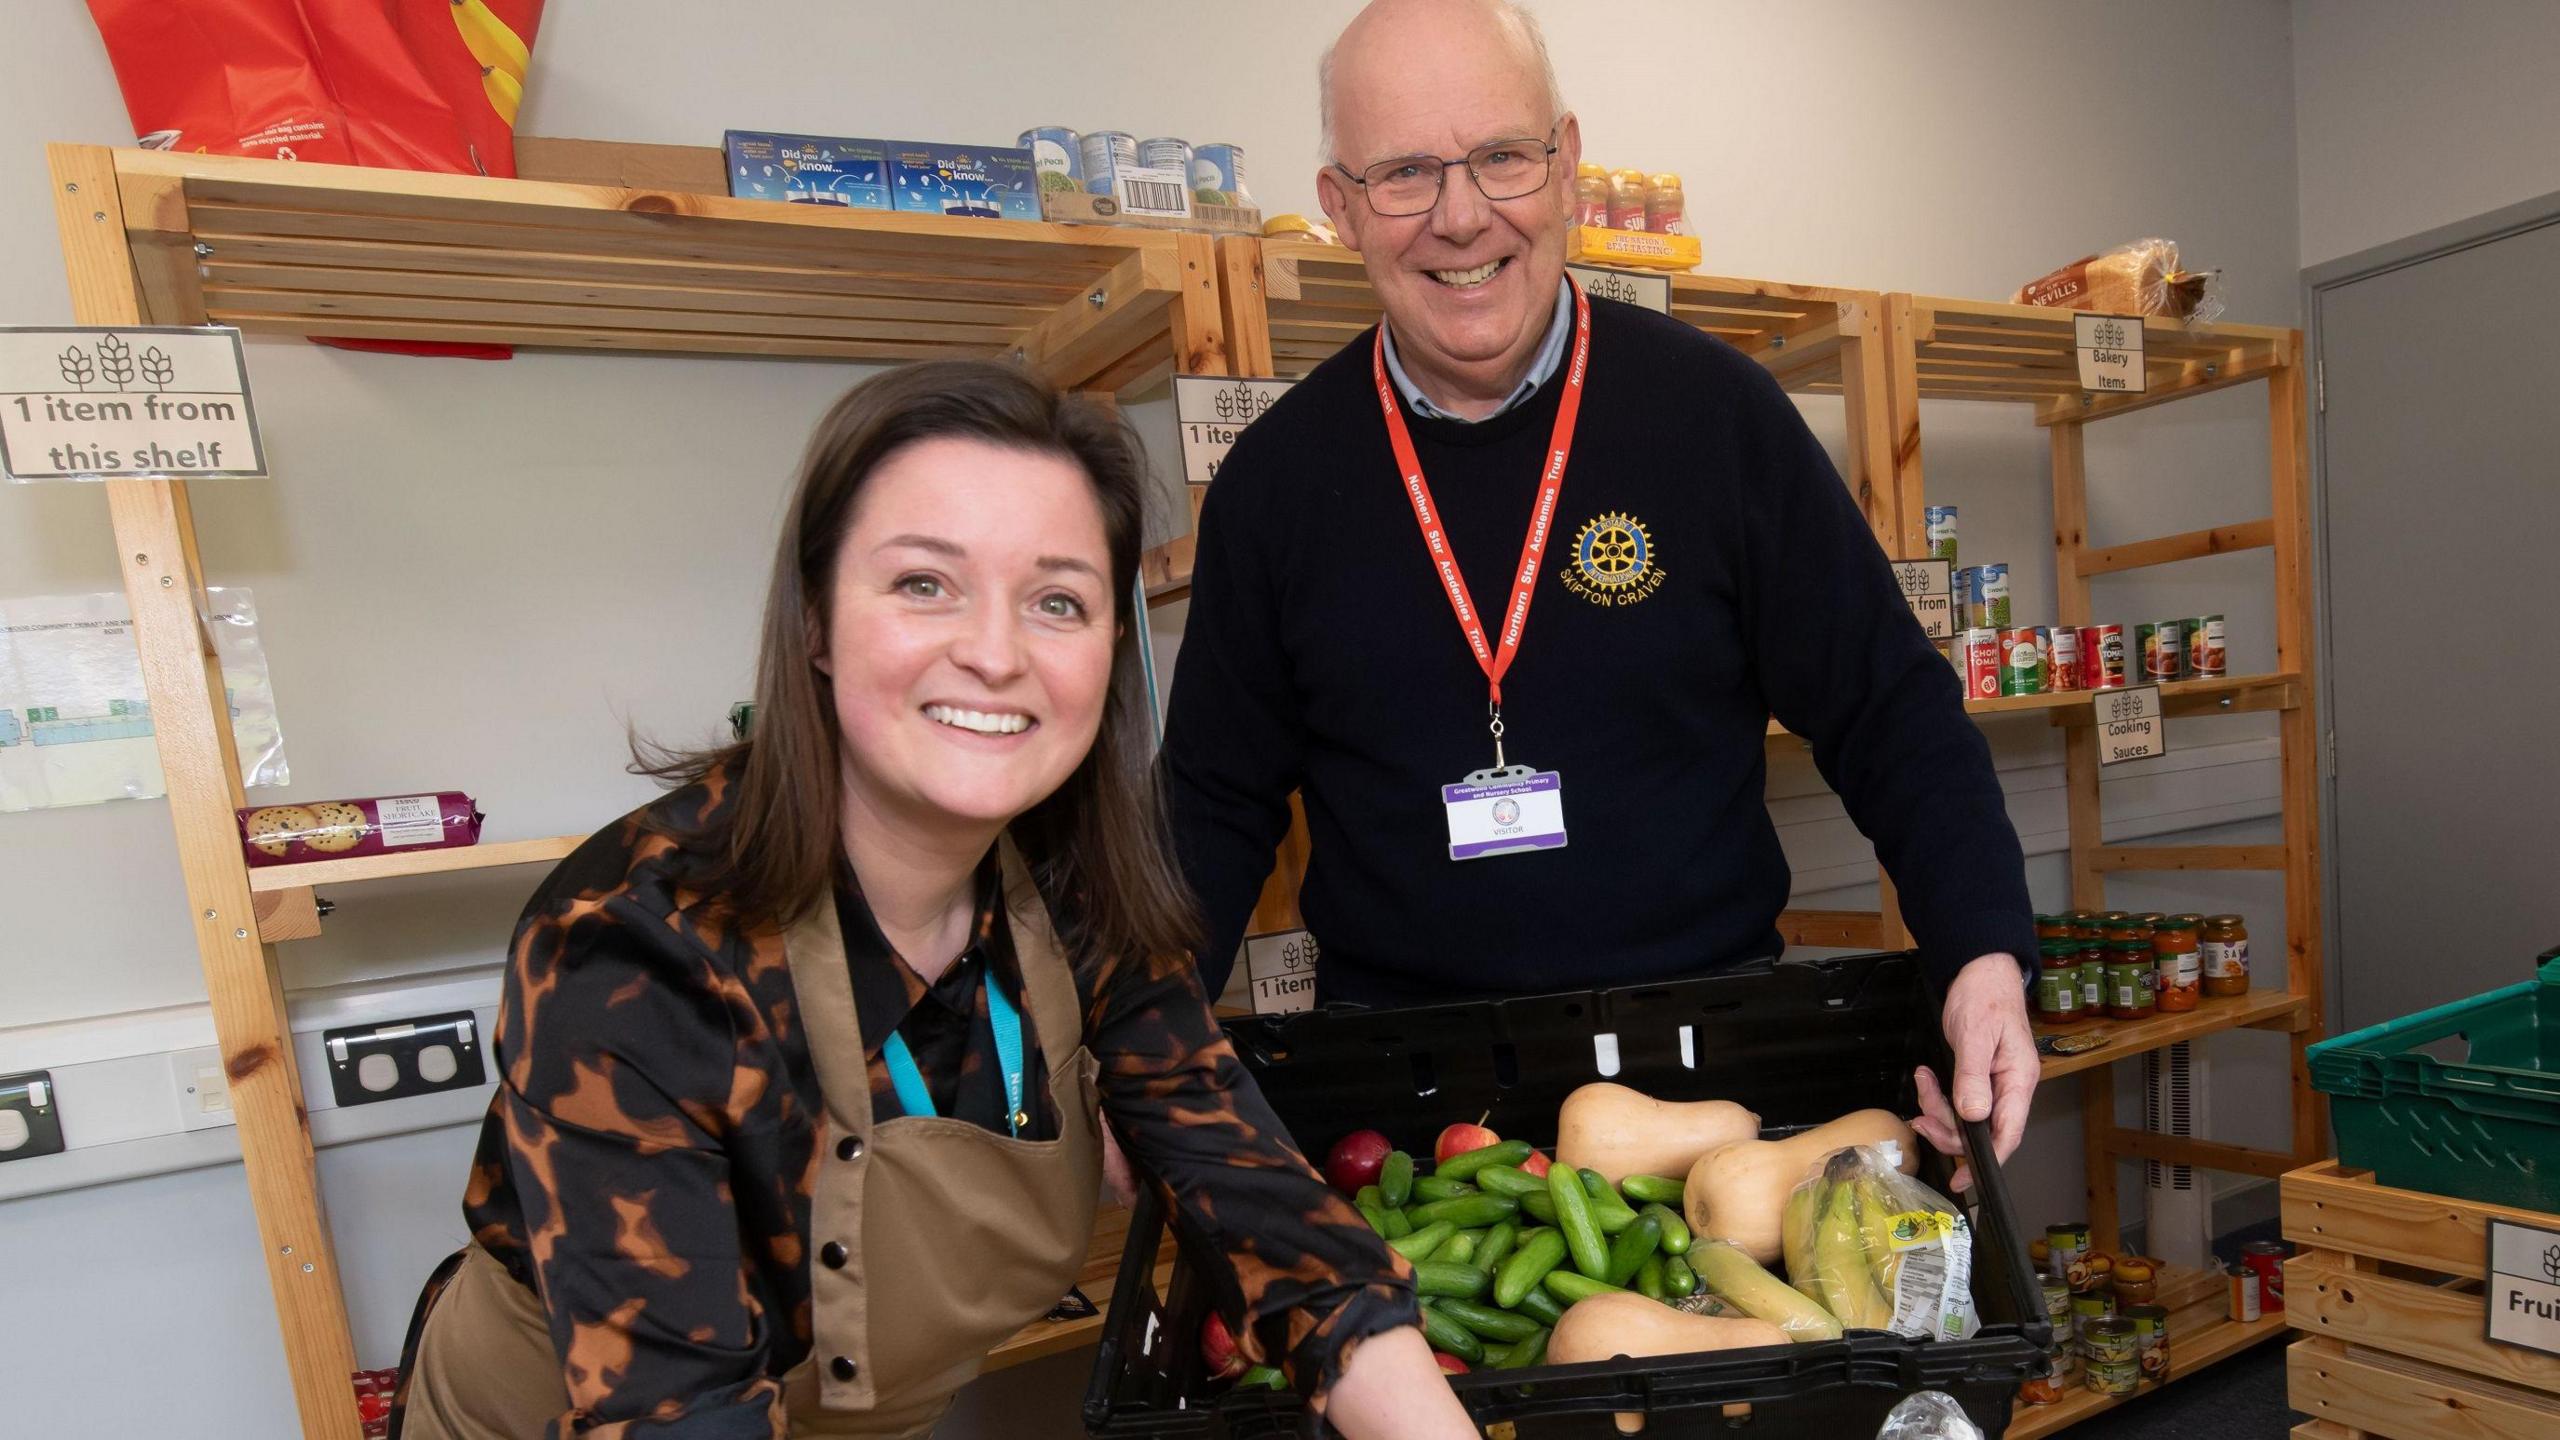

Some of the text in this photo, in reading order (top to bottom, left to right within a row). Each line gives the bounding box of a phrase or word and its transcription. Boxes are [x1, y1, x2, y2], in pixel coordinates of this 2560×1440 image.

[293, 122, 325, 131] contains
[781, 149, 800, 159] Did
[799, 161, 842, 173] know...
[937, 160, 971, 171] Did you
[1044, 158, 1064, 166] Peas
[953, 170, 993, 182] know...
[2032, 281, 2078, 306] NEVILL'S
[1570, 336, 1587, 387] Northern
[2093, 350, 2128, 367] Bakery
[2098, 374, 2126, 389] Items
[1380, 383, 1393, 416] Trust
[14, 394, 235, 422] 1 item from
[1190, 424, 1238, 444] 1 ite
[49, 441, 222, 471] this shelf
[1600, 518, 1629, 530] ROTARY
[1505, 450, 1564, 646] Northern Star Academies Trust
[1408, 475, 1487, 659] Northern Star Academies Trust
[1560, 568, 1667, 607] SKIPTON CRAVEN
[1919, 596, 1946, 610] from
[1922, 621, 1941, 636] elf
[2108, 719, 2151, 737] Cooking
[2113, 745, 2149, 760] Sauces
[1525, 777, 1550, 787] Primary
[1486, 789, 1510, 799] Nursery
[1511, 786, 1532, 795] School
[1494, 826, 1524, 836] VISITOR
[1260, 981, 1269, 998] 1
[2509, 1290, 2560, 1321] Frui
